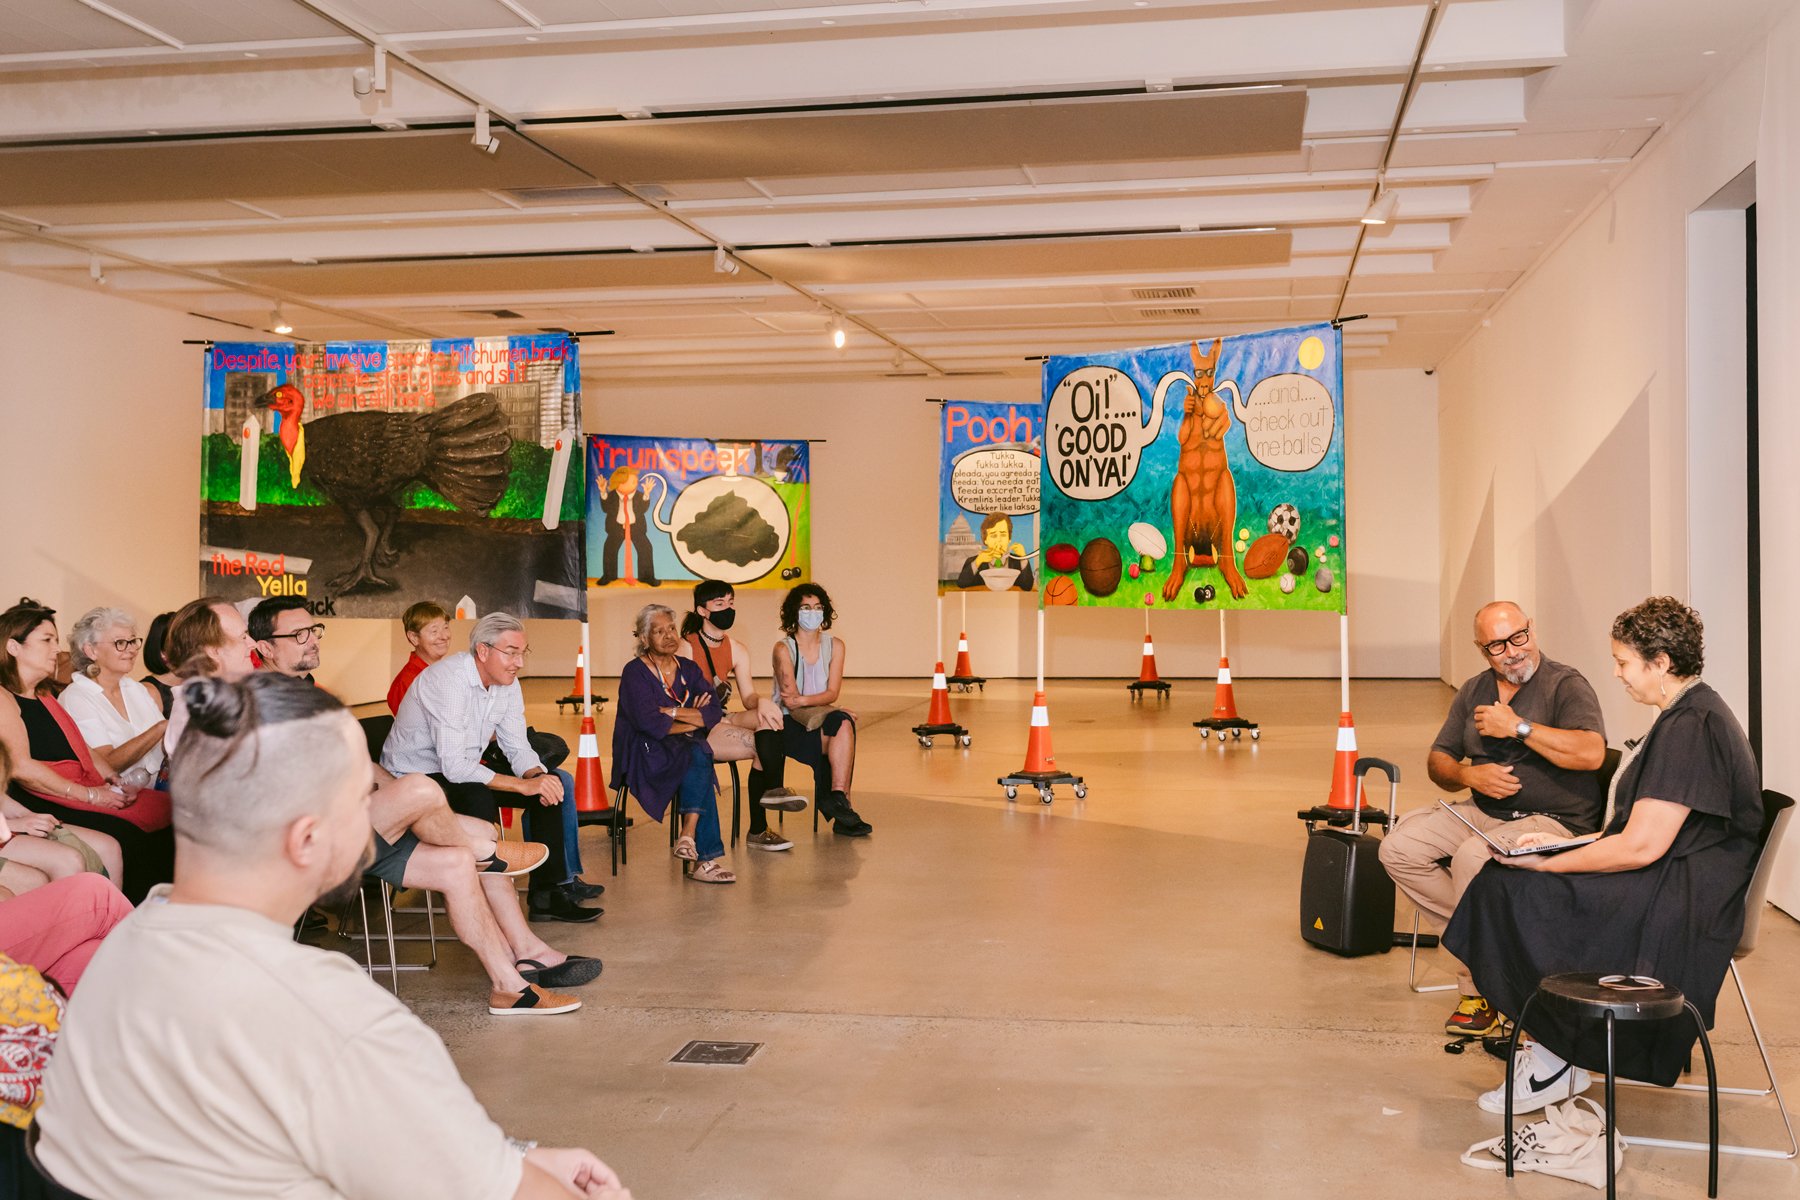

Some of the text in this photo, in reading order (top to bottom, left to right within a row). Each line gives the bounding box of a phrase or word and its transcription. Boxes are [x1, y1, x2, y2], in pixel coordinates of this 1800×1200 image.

[284, 352, 318, 376] your
[465, 364, 495, 386] and
[337, 391, 367, 409] are
[1249, 404, 1329, 433] check out
[1256, 431, 1326, 458] me balls.
[990, 452, 1015, 460] Tukka
[996, 478, 1024, 486] needa
[1000, 469, 1033, 479] agreeda
[957, 486, 984, 495] feeda
[986, 486, 1023, 495] excreta
[974, 503, 998, 512] lekker
[999, 502, 1013, 511] like
[212, 552, 285, 576] the Red
[256, 574, 307, 596] Yella
